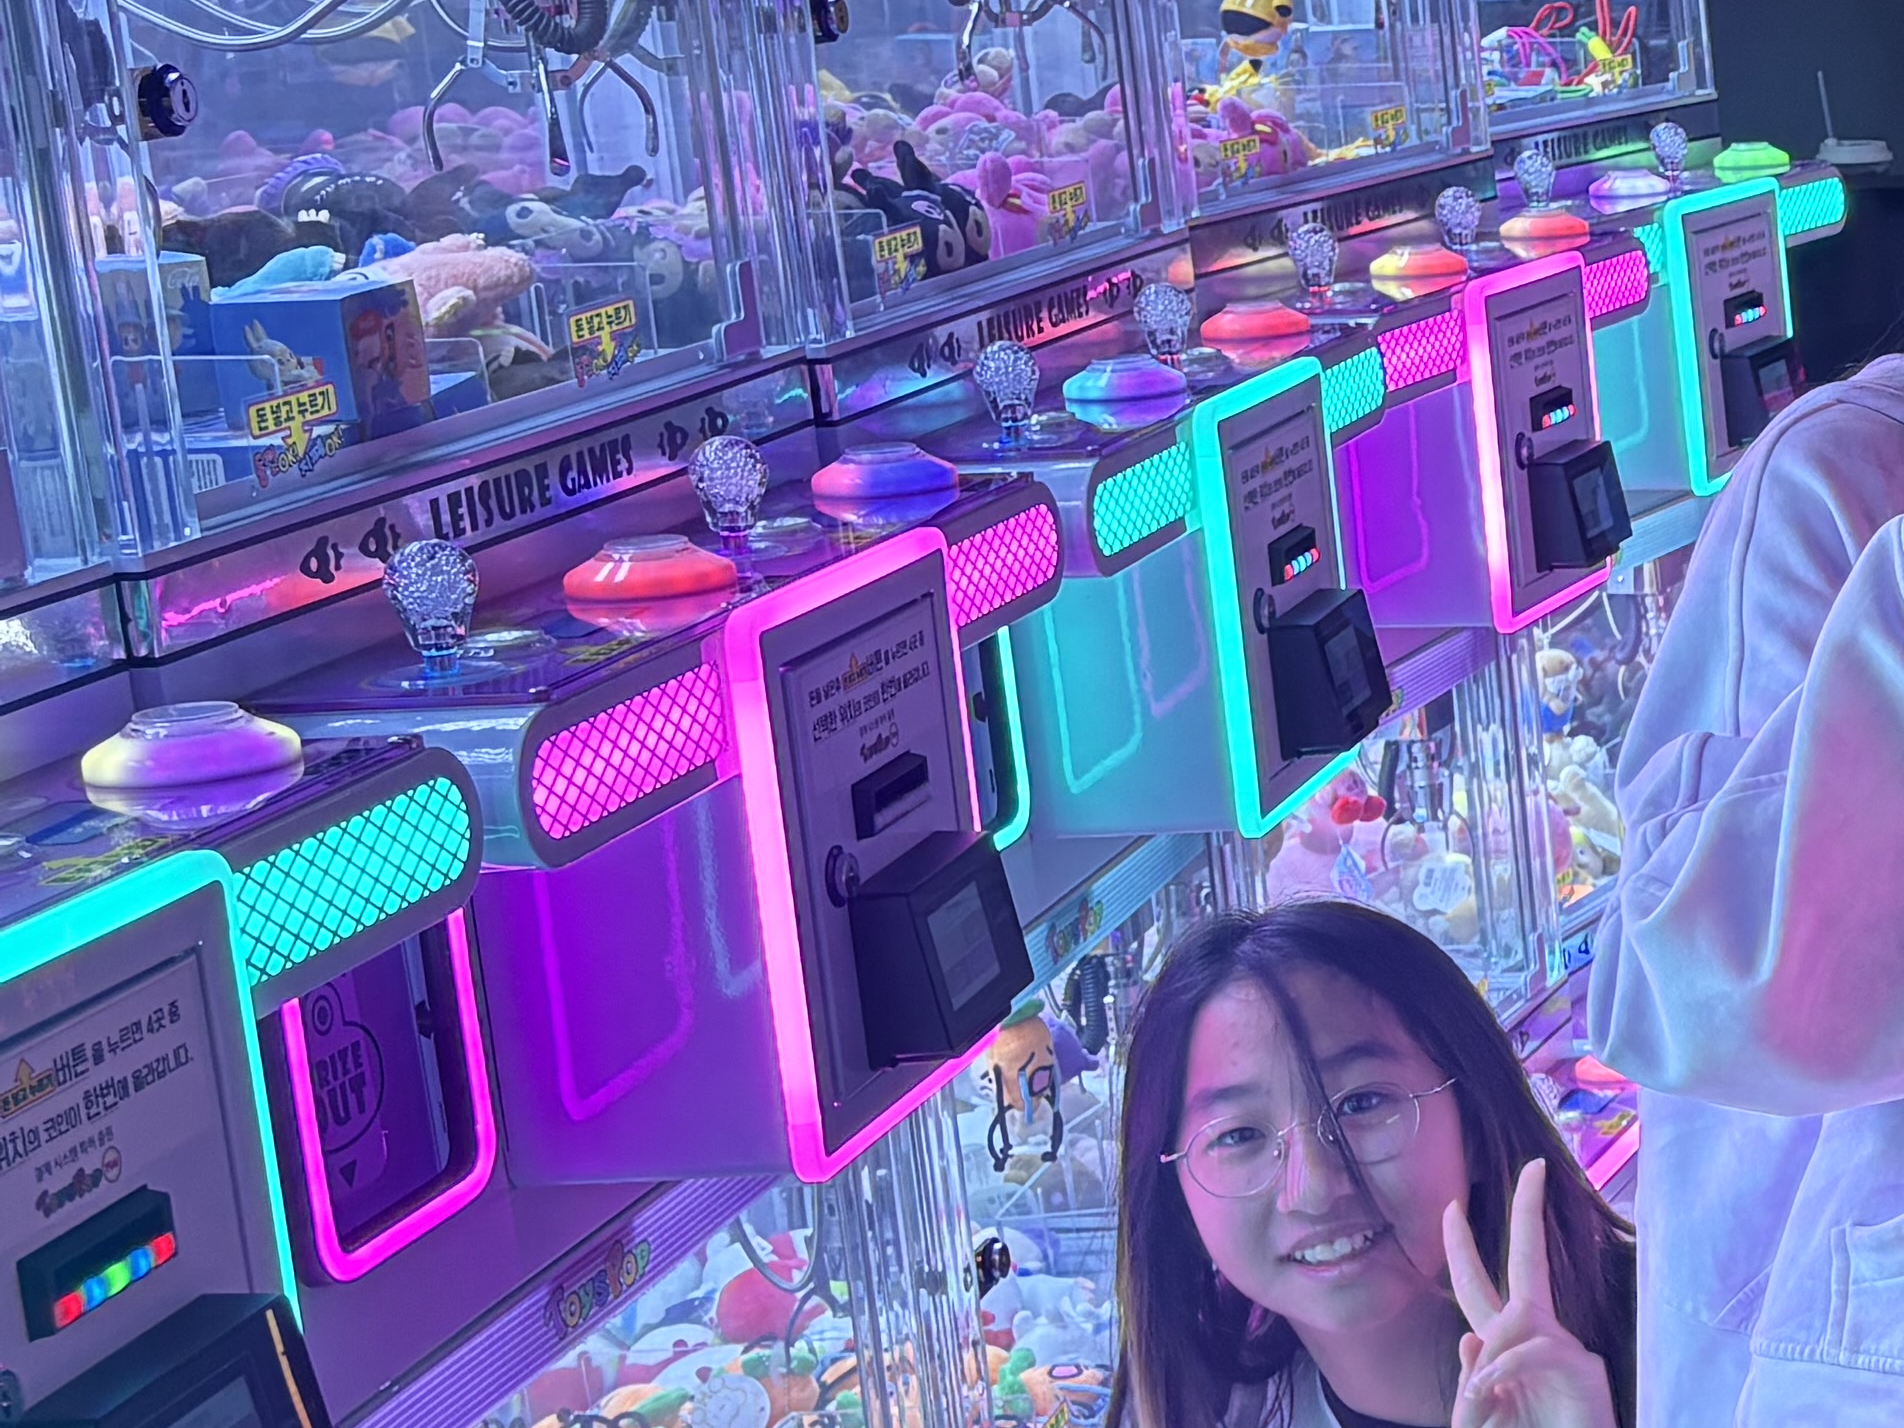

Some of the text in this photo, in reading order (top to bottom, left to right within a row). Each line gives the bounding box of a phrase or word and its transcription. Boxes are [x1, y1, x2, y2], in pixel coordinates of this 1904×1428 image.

[256, 388, 332, 431] 돈 넣고 누르기
[429, 433, 635, 541] LEISURE GAMES
[315, 1039, 365, 1090] RIZE
